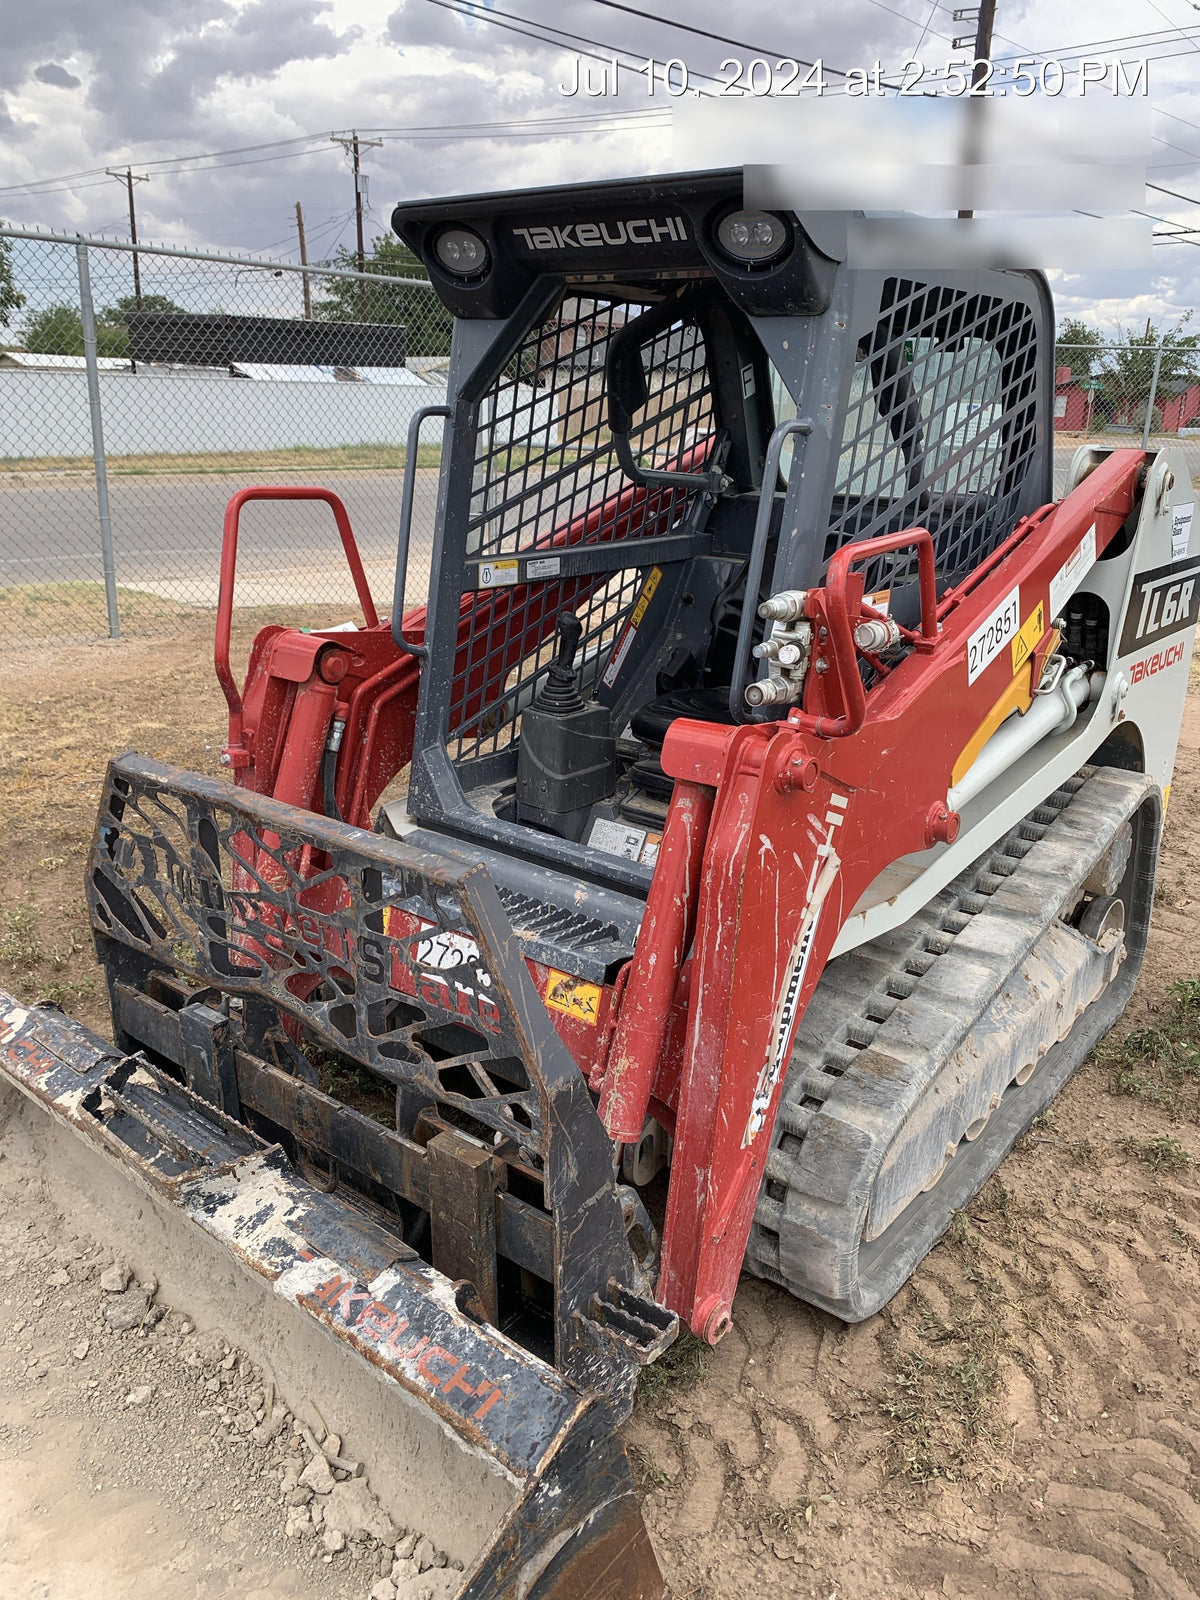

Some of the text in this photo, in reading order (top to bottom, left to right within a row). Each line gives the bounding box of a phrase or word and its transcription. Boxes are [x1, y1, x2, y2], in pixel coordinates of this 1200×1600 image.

[512, 216, 688, 250] TAKEUCHI
[1136, 567, 1200, 640] TL6R
[969, 600, 1017, 674] 272851
[1129, 641, 1185, 685] TAKEUCHI
